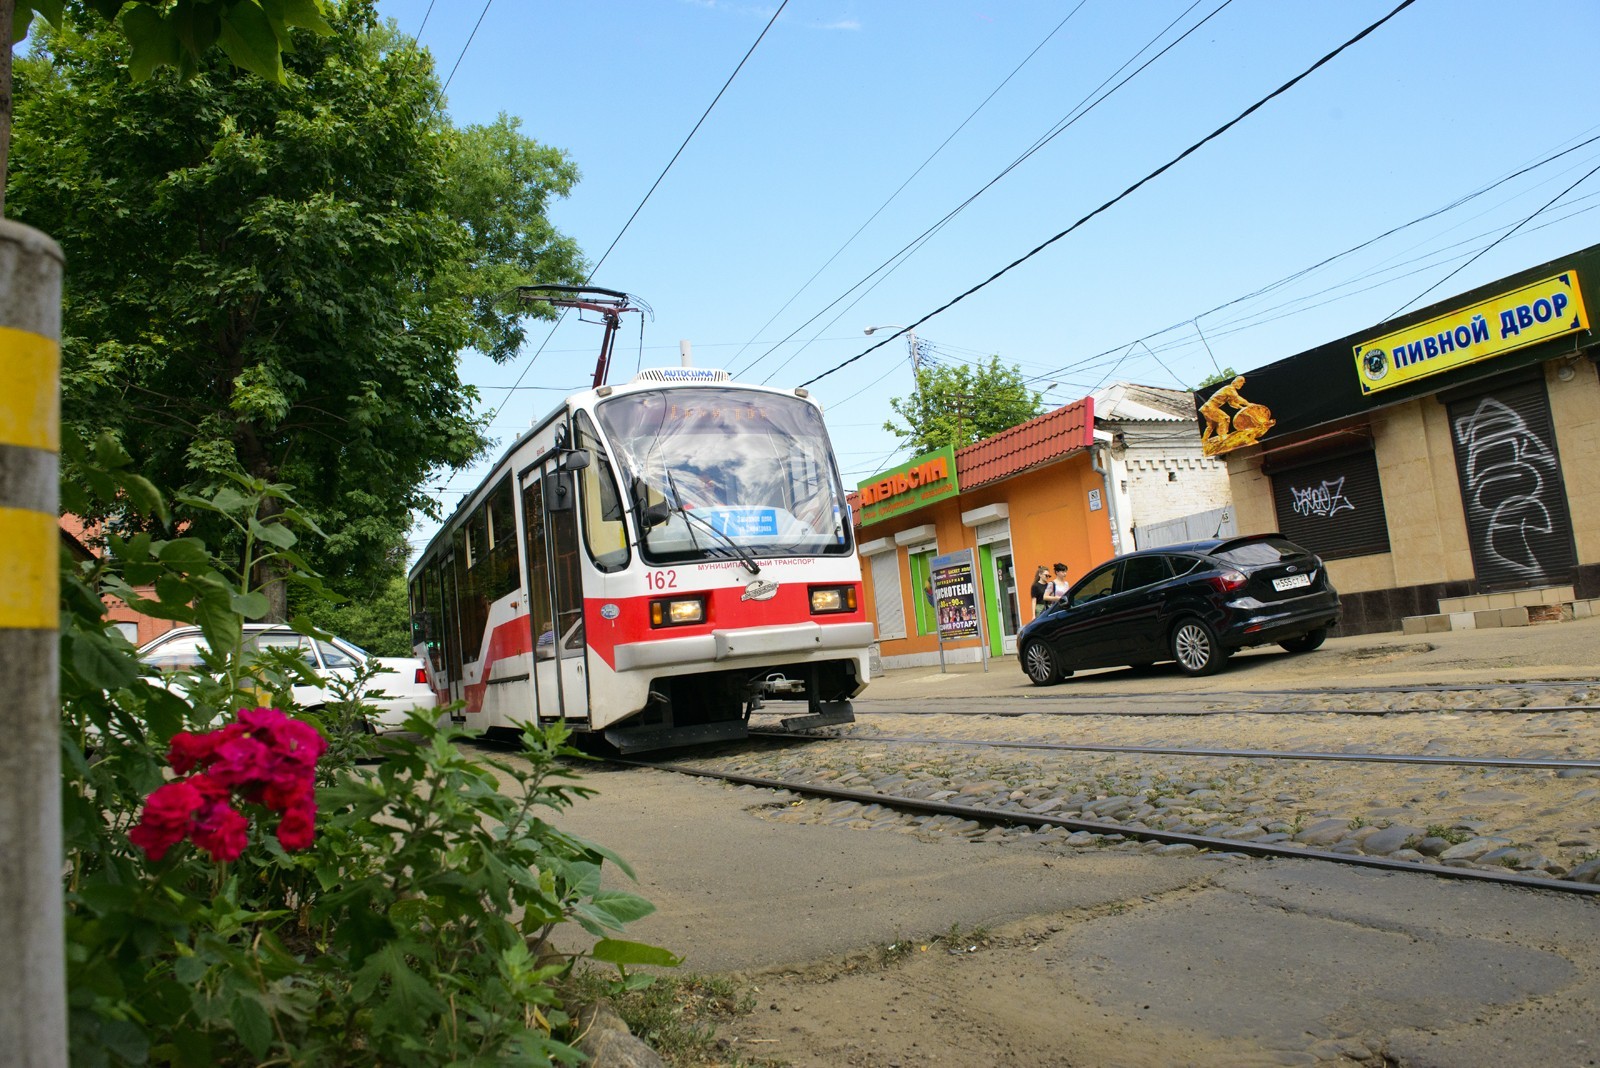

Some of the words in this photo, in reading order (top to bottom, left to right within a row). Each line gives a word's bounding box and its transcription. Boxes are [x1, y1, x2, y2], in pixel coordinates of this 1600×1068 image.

[1393, 314, 1490, 369] ПИВНОЙ
[1500, 292, 1569, 340] ДВОР
[664, 369, 714, 378] AUTOCLIMA
[859, 456, 948, 507] АПЕЛЬСИН
[719, 512, 730, 535] 7
[774, 558, 816, 566] ТРАНСПОРТ
[645, 569, 678, 591] 162
